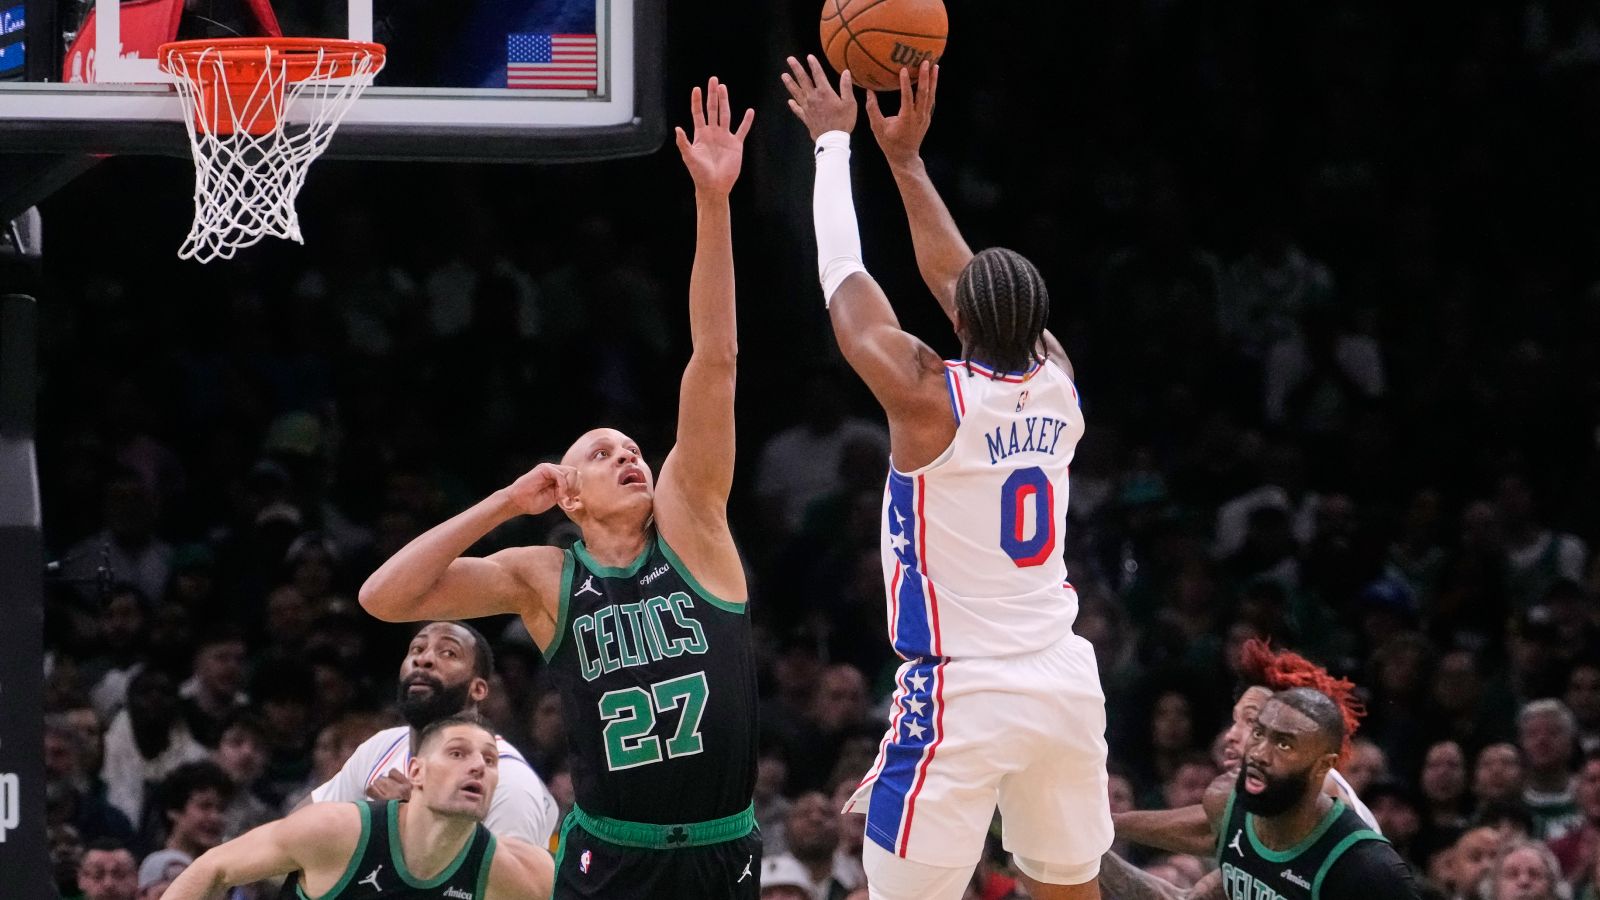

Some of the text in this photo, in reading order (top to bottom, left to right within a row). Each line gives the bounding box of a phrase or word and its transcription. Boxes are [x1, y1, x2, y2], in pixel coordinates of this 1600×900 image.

[984, 417, 1067, 465] MAXEY
[1000, 466, 1056, 568] 0
[639, 563, 670, 586] Amica
[573, 592, 709, 682] CELTICS
[598, 671, 710, 772] 27
[443, 886, 473, 900] Amica
[1280, 868, 1311, 890] Amica
